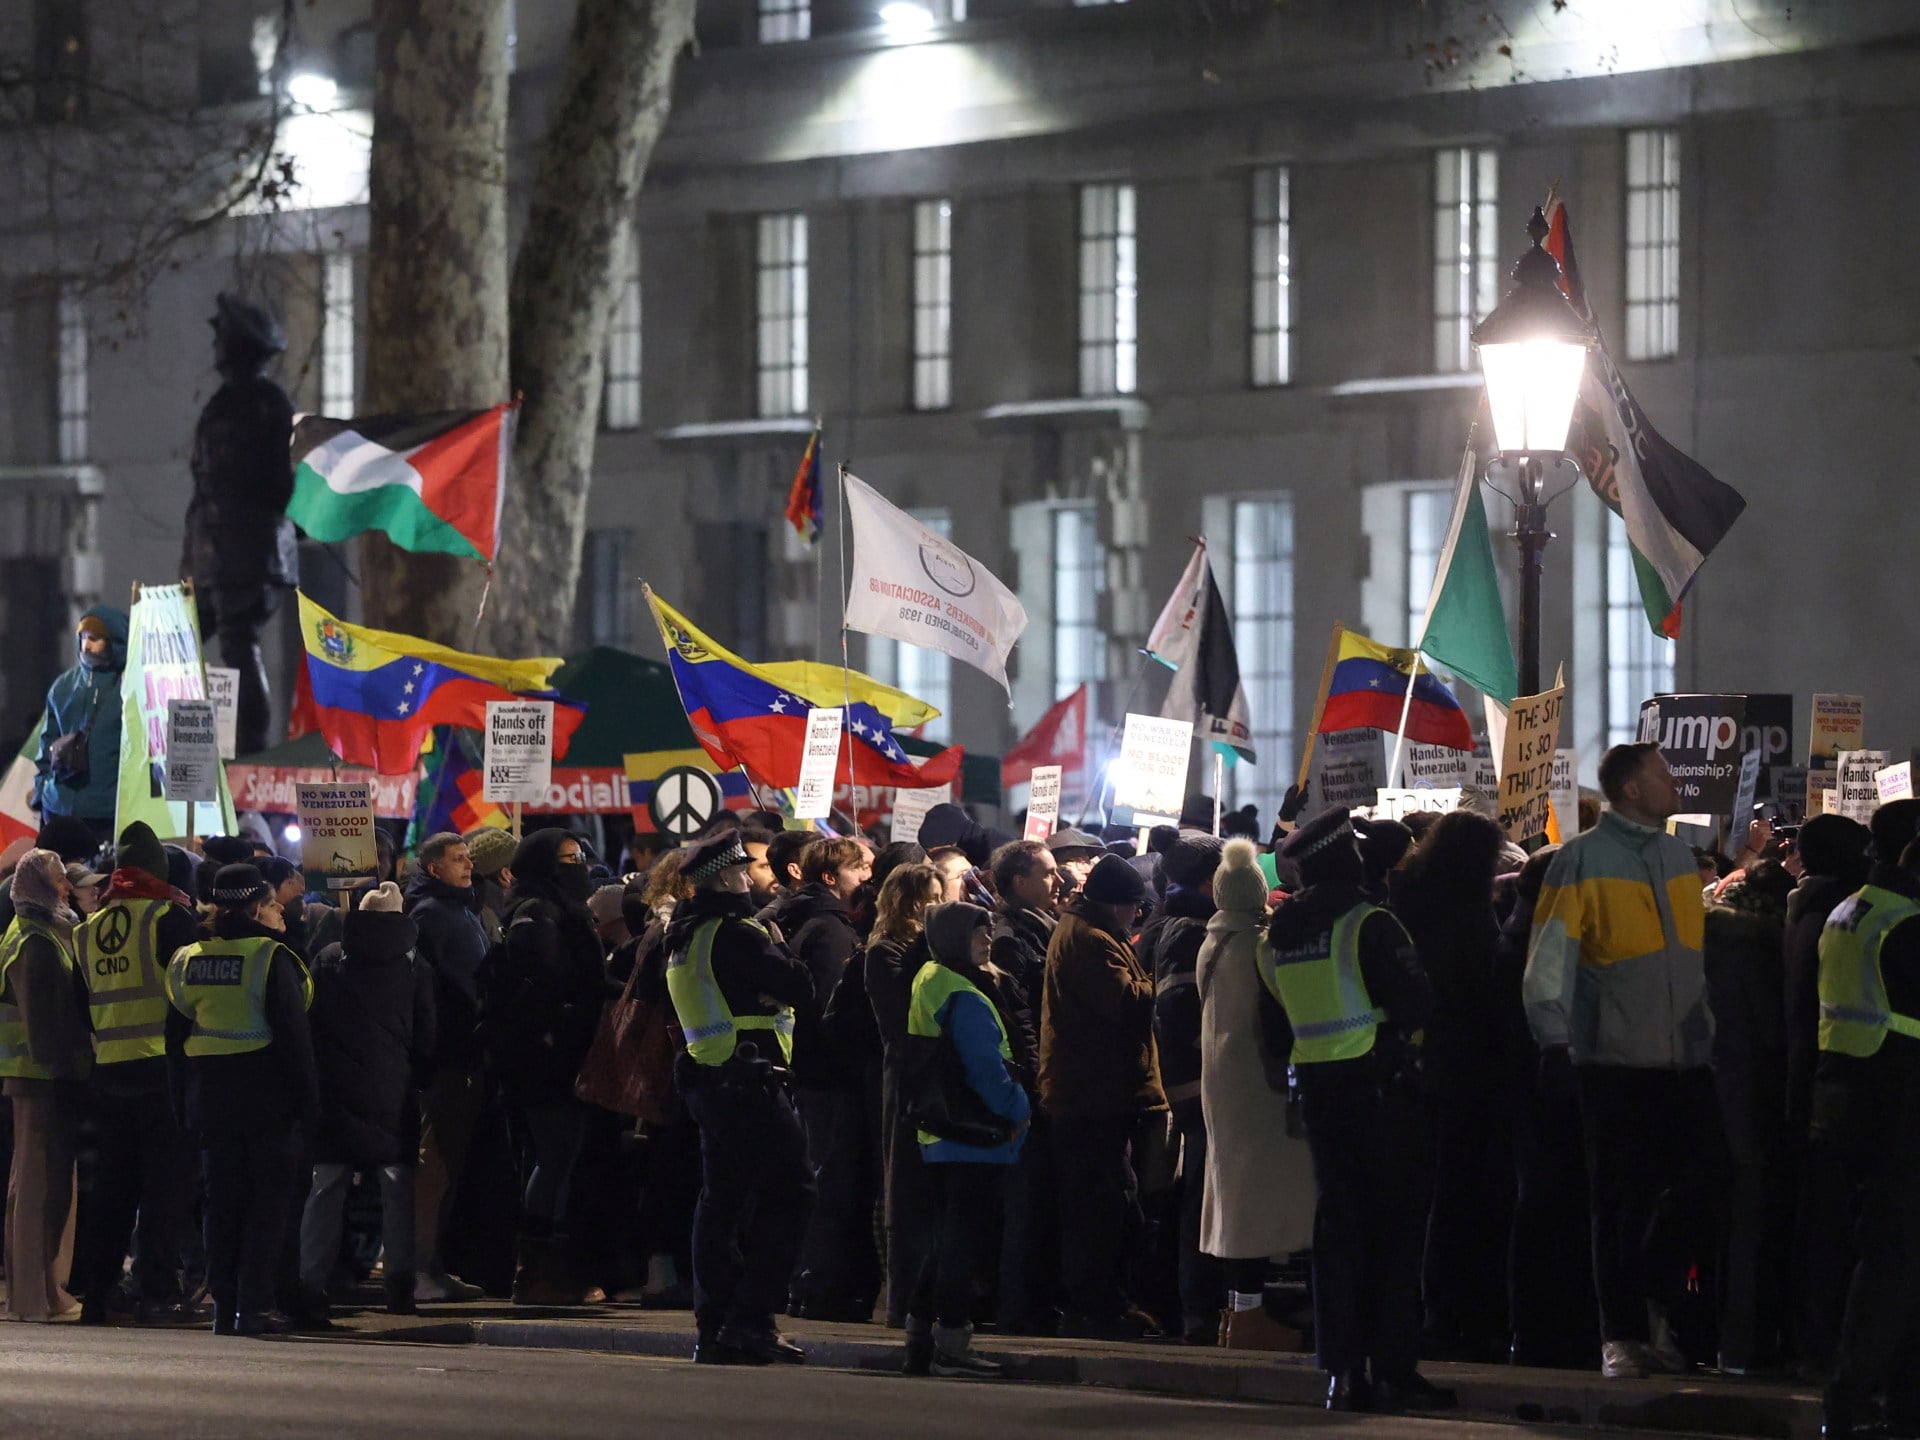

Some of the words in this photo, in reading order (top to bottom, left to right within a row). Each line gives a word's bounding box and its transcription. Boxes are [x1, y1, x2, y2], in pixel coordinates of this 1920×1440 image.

[174, 713, 200, 728] Hands
[201, 713, 214, 728] off
[493, 715, 525, 729] Hands
[528, 715, 546, 729] off
[1515, 704, 1540, 731] THE
[174, 730, 214, 744] Venezuela
[492, 731, 546, 745] Venezuela
[1640, 707, 1737, 761] Tump
[1410, 745, 1444, 761] Hands
[1519, 742, 1533, 762] IS
[1536, 734, 1551, 755] SO
[1411, 759, 1467, 776] Venezuela
[1554, 762, 1570, 775] off
[1669, 764, 1733, 779] lationship?
[1843, 766, 1870, 782] Hands
[1475, 771, 1497, 785] Han
[302, 791, 316, 800] NO
[320, 791, 347, 799] WAR
[350, 790, 366, 798] ON
[1684, 784, 1700, 797] No
[1842, 785, 1879, 801] Venezue
[302, 800, 368, 809] VENEZUELA
[303, 817, 321, 827] NO
[325, 816, 369, 827] BLOOD
[312, 828, 336, 838] FOR
[340, 828, 362, 838] OIL
[95, 955, 130, 976] CND
[187, 960, 241, 981] POLICE
